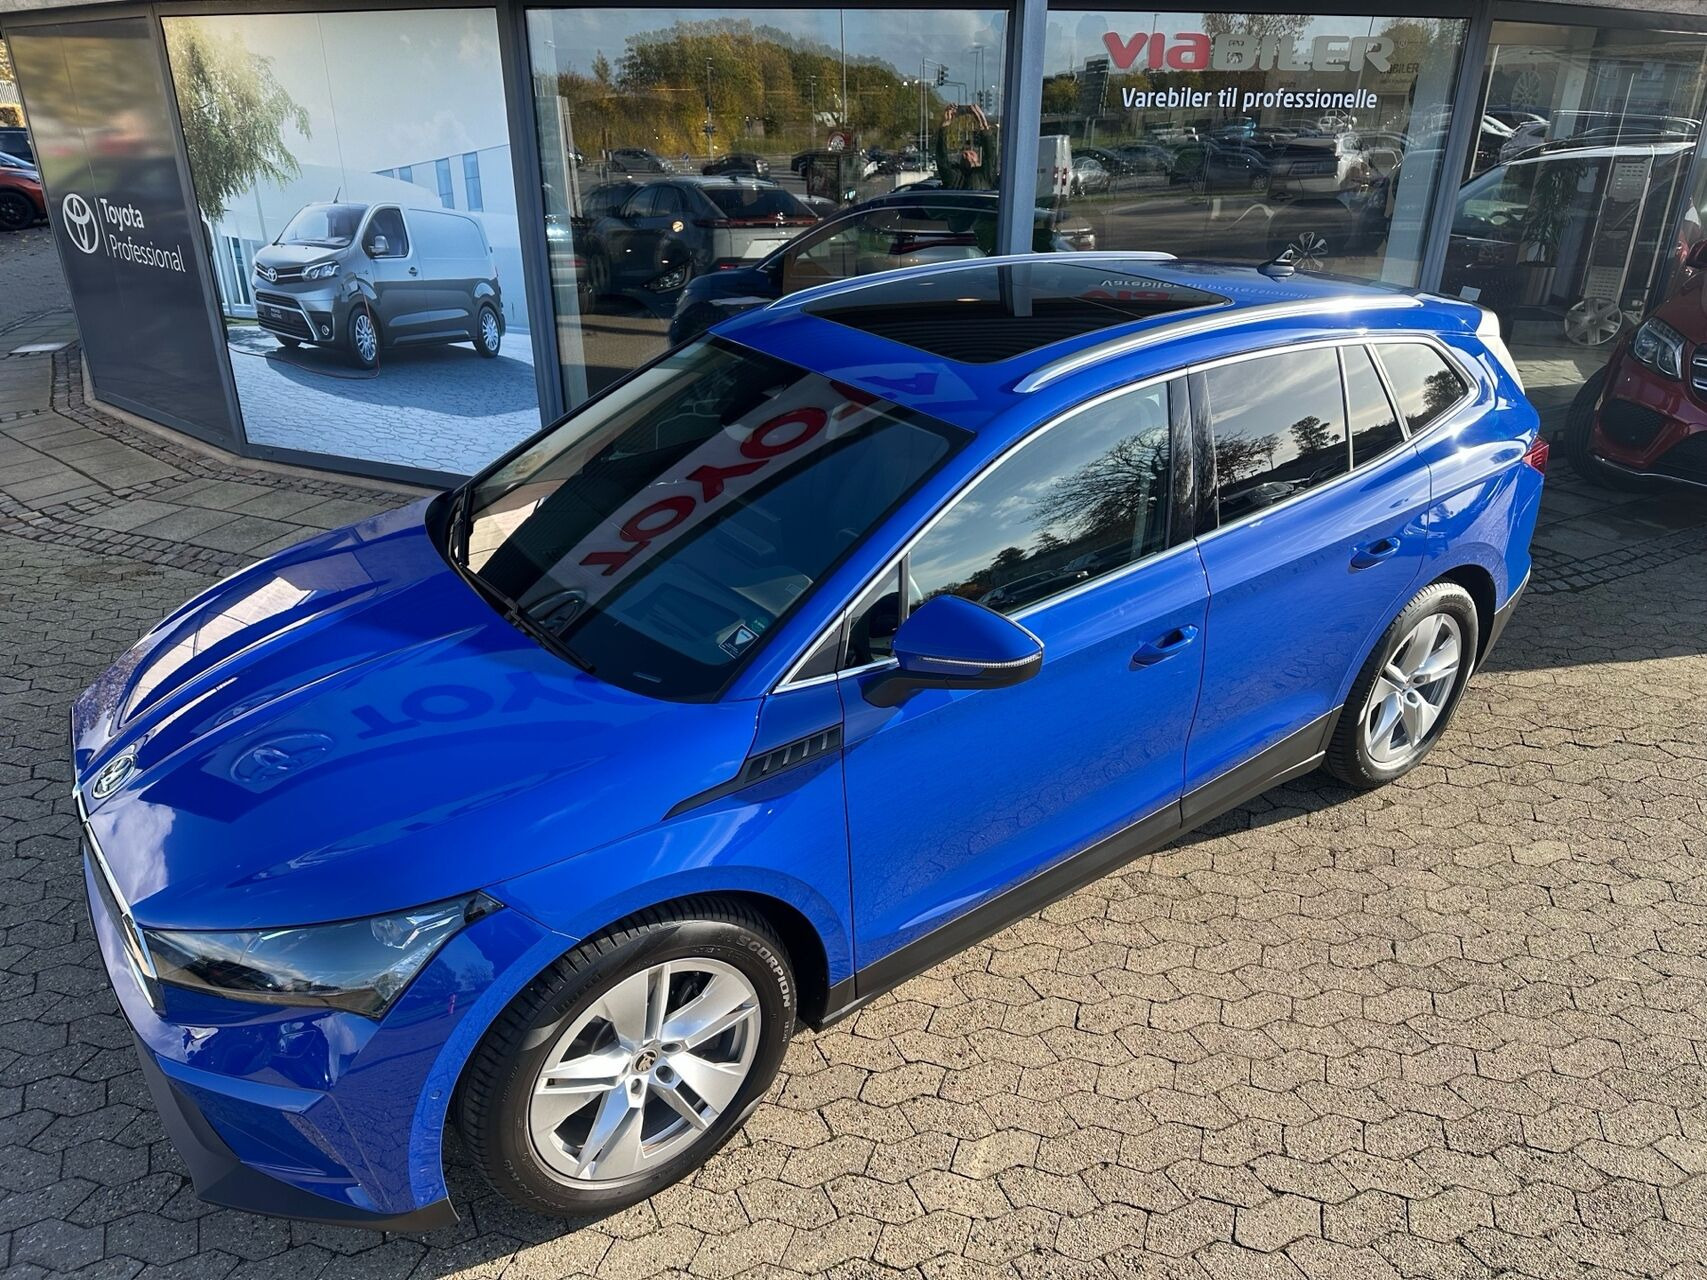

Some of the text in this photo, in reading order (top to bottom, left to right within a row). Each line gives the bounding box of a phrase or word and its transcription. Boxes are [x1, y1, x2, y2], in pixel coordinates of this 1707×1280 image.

[1122, 86, 1377, 113] Varebiler til professionelle
[100, 198, 145, 232] Toyota
[109, 234, 186, 273] Professional
[736, 934, 791, 1008] SCORPION
